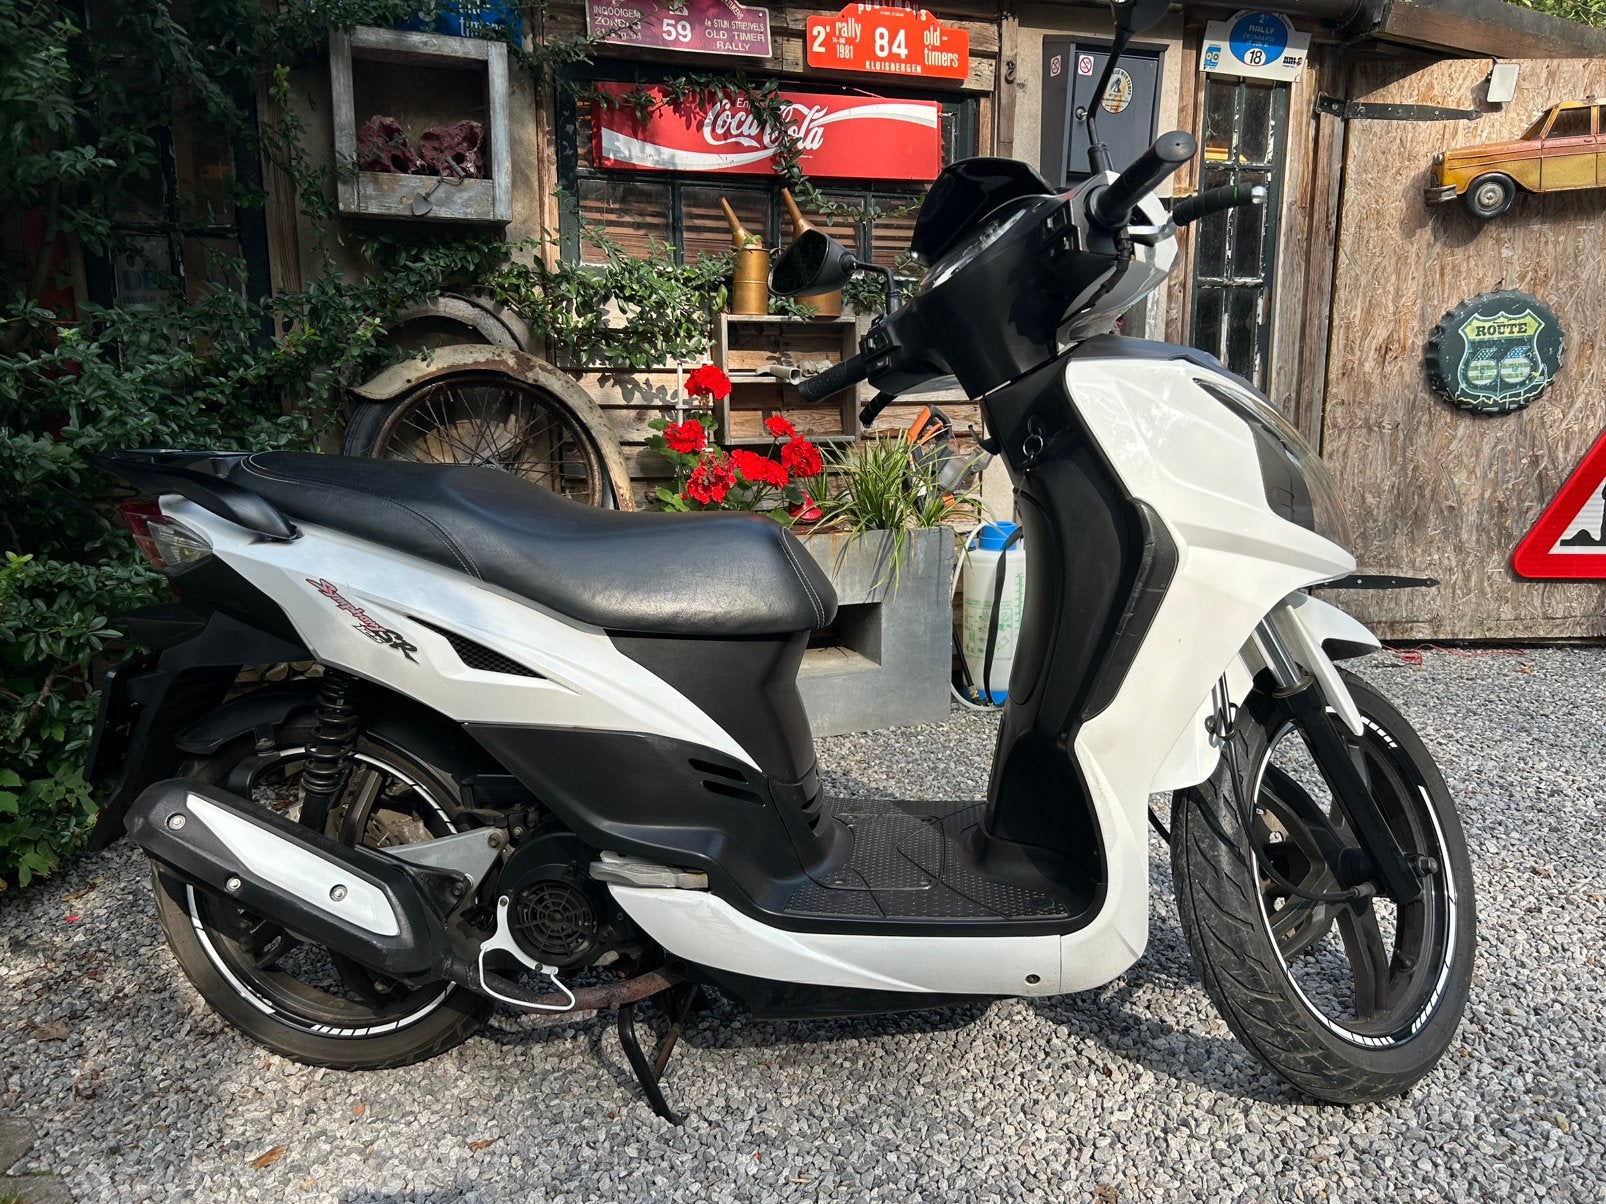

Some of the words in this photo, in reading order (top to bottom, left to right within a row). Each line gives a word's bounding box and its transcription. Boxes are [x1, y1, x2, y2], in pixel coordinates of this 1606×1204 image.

[662, 18, 692, 43] 59
[705, 29, 728, 39] OLD
[733, 31, 765, 42] TIMER
[836, 17, 862, 43] rally
[1248, 24, 1276, 35] RALLY
[716, 40, 750, 52] RALLY
[836, 43, 854, 60] 1981
[875, 26, 908, 60] 84
[923, 45, 959, 69] timers
[1249, 49, 1263, 65] 18
[865, 60, 922, 74] KLUISBERGEN
[1475, 322, 1528, 337] ROUTE
[1466, 346, 1532, 386] 66
[375, 627, 421, 665] SR
